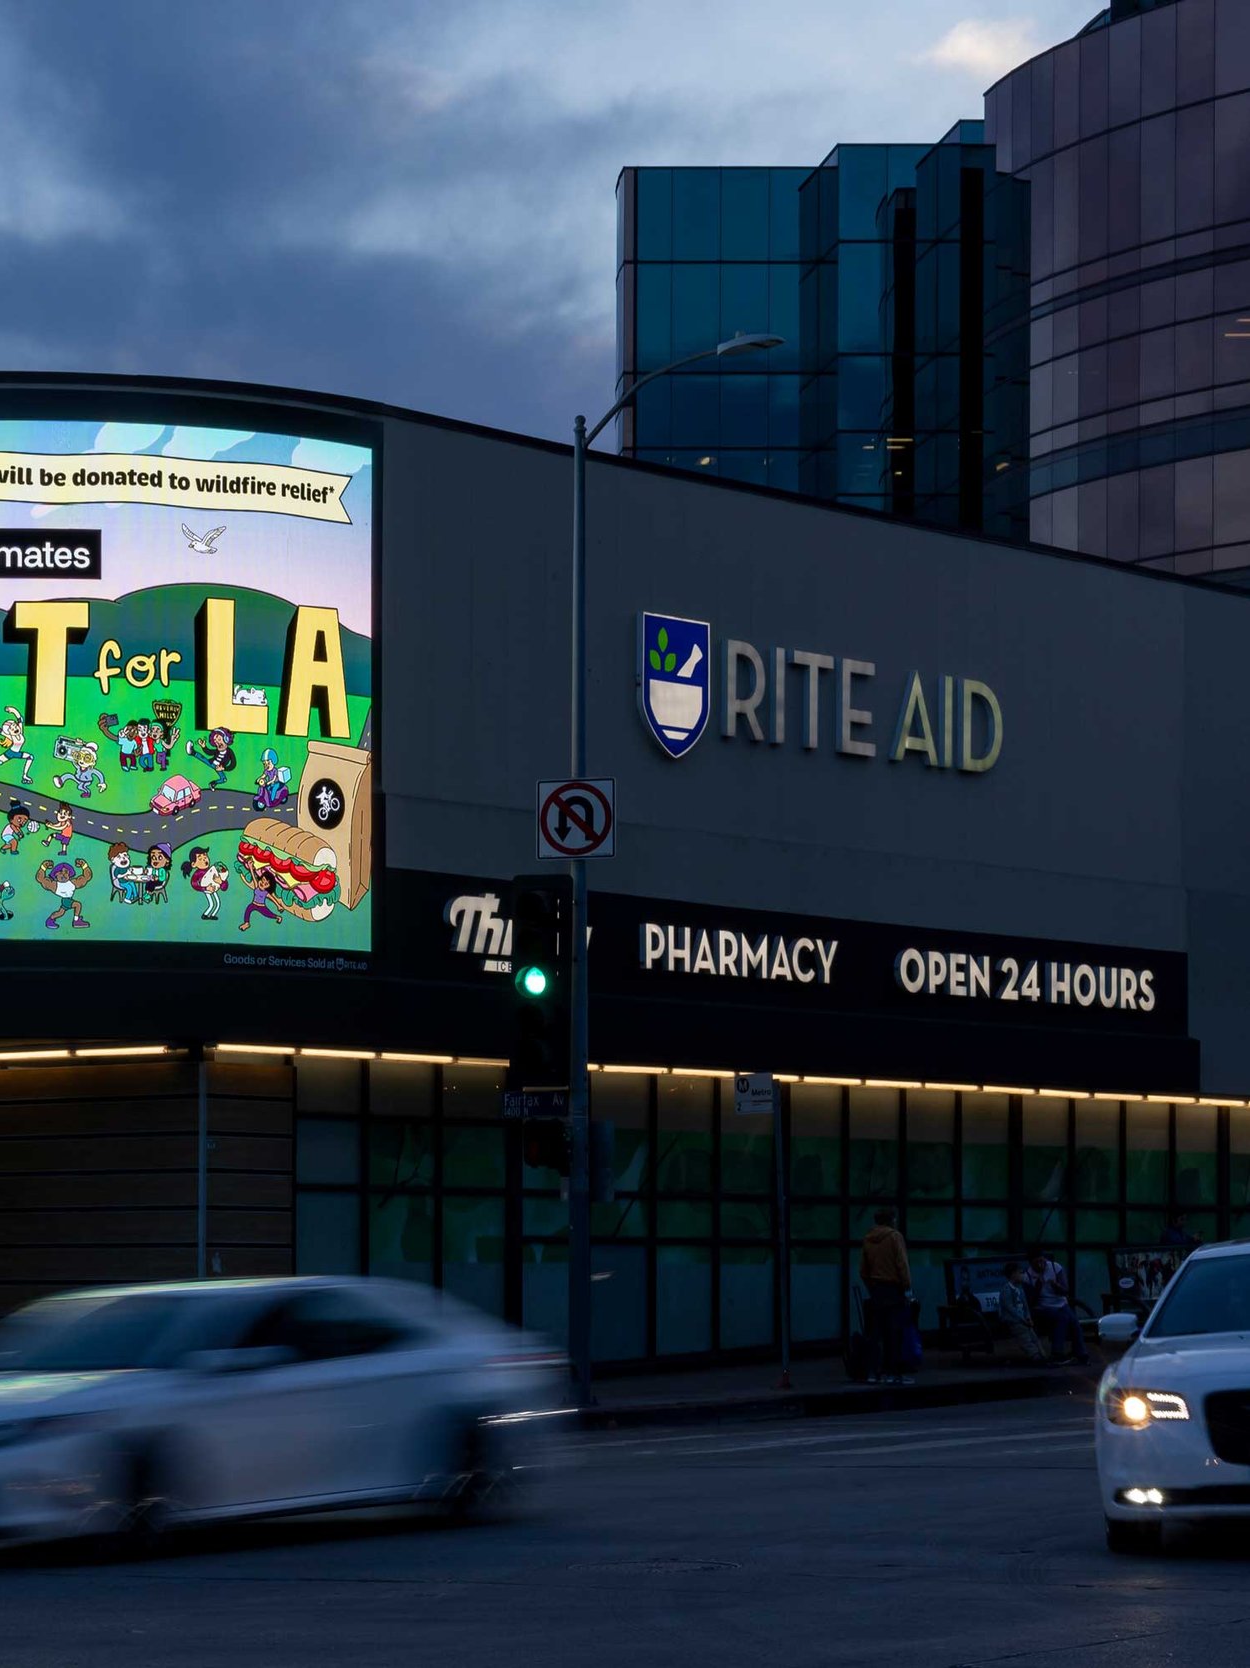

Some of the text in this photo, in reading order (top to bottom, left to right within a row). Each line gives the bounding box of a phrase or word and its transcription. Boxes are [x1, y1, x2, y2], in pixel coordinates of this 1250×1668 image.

[40, 468, 66, 486] be
[72, 468, 162, 488] donated
[168, 473, 190, 490] to
[196, 475, 276, 496] wildfire
[93, 639, 181, 696] for
[195, 597, 351, 739] LA
[723, 638, 1003, 773] RITE AID
[223, 953, 256, 965] Goods
[257, 957, 267, 966] or
[269, 955, 307, 968] Services
[307, 957, 327, 969] Sold
[326, 959, 336, 969] at
[643, 922, 839, 985] PHARMACY
[900, 947, 991, 998] OPEN
[1000, 957, 1041, 1001] 24
[1050, 961, 1156, 1012] HOURS
[751, 1088, 773, 1096] Metro
